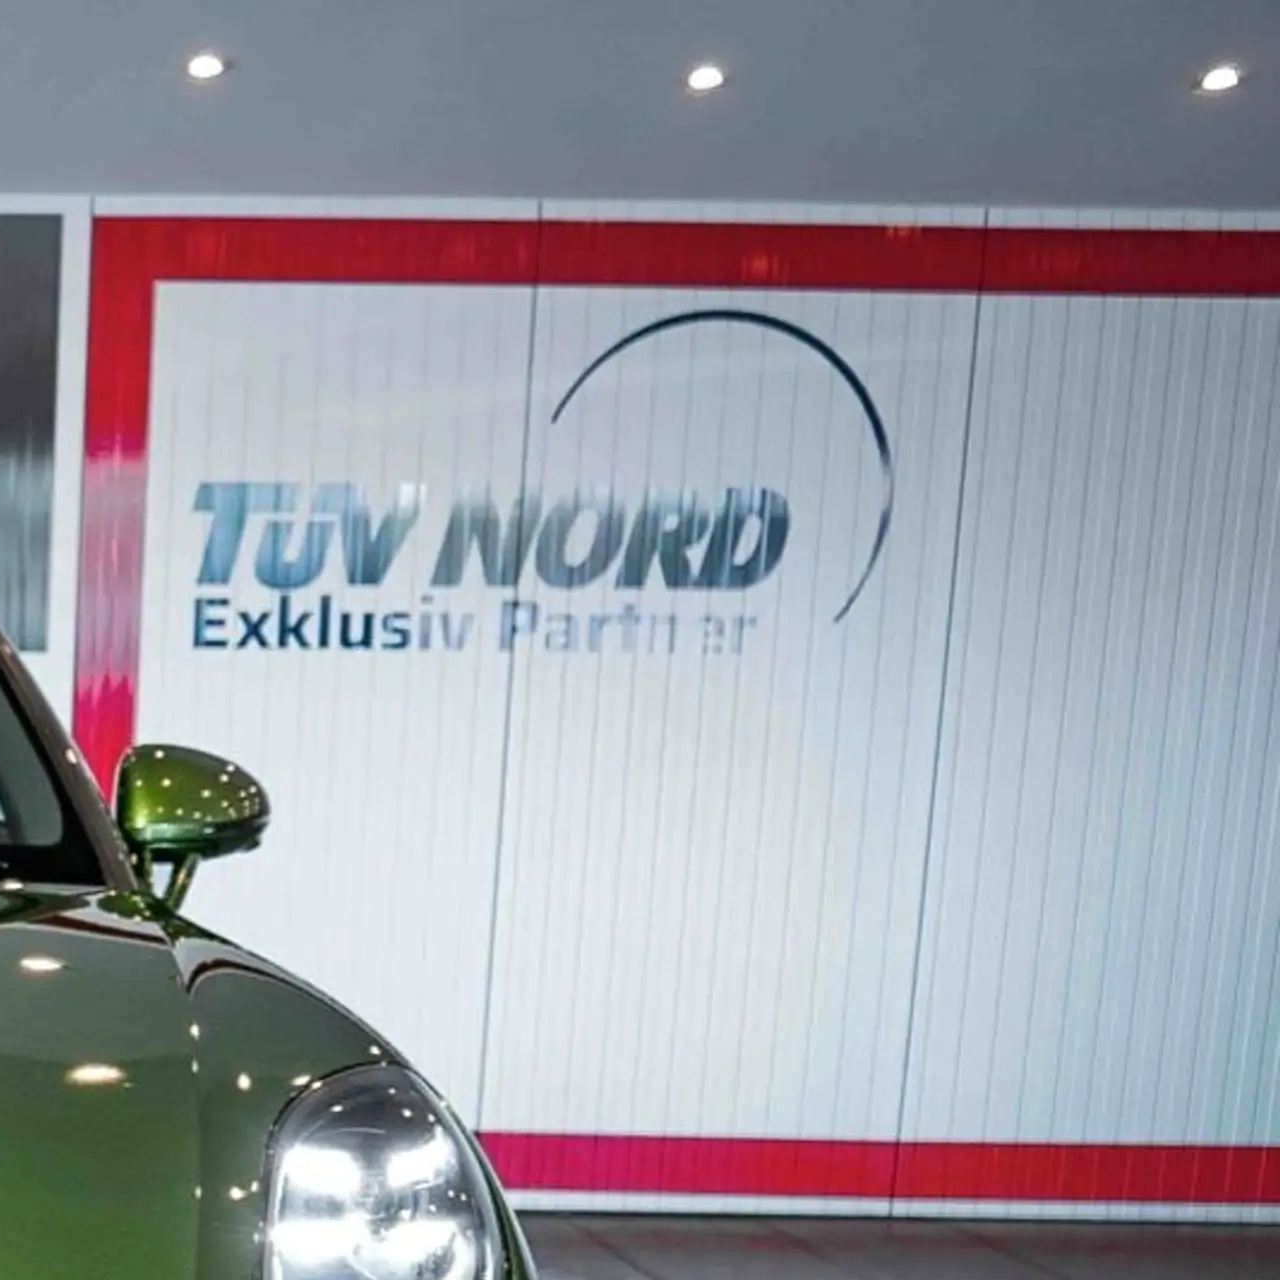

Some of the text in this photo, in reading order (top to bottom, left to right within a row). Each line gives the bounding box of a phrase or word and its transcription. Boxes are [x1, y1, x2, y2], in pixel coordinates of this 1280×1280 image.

[192, 481, 792, 590] TÜV NORD
[192, 597, 474, 651] Exklusiv
